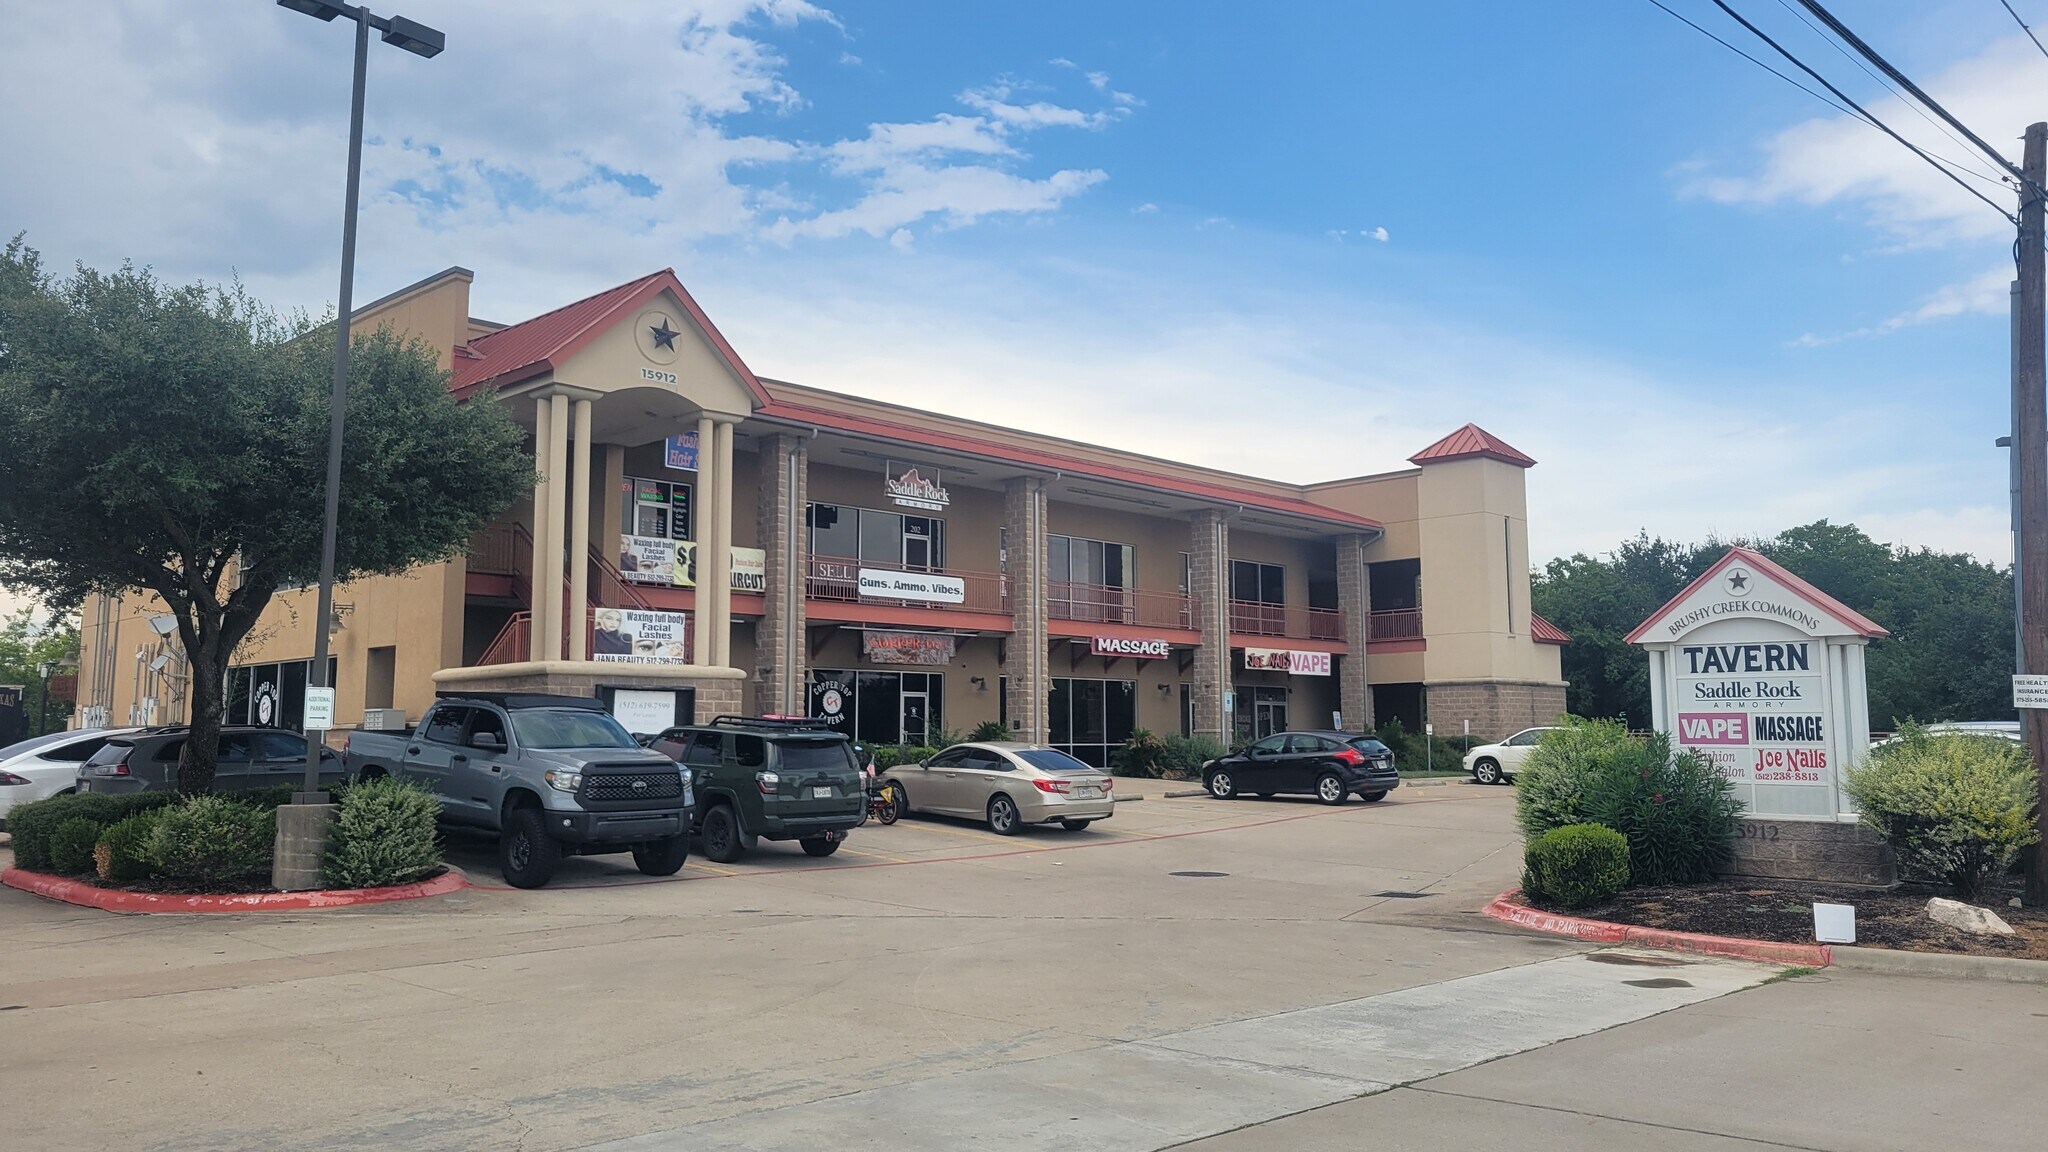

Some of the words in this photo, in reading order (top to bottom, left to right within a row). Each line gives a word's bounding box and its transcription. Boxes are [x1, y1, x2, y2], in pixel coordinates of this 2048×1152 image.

[641, 368, 677, 384] 15912
[669, 449, 693, 468] Hair
[640, 491, 664, 501] WAXING
[888, 479, 922, 498] Saddle
[924, 485, 950, 502] Rock
[898, 499, 940, 510] ARMORY
[910, 525, 921, 534] 202
[633, 538, 653, 549] Waxing
[660, 540, 675, 550] body
[644, 547, 665, 556] Facial
[641, 553, 666, 561] Lashes
[819, 563, 852, 579] SELL
[859, 576, 891, 589] Guns.
[893, 580, 929, 593] Ammo.
[931, 583, 964, 596] Vibes.
[626, 611, 653, 623] Waxing
[654, 613, 667, 622] full
[667, 613, 685, 626] body
[1668, 605, 1712, 636] BRUSHY
[1712, 600, 1751, 615] CREEK
[1751, 600, 1820, 631] COMMONS
[639, 630, 673, 640] Lashes
[642, 623, 671, 632] Facial
[1097, 637, 1170, 656] MASSAGE
[595, 655, 616, 663] JANA
[1291, 653, 1329, 673] VAPE
[1683, 643, 1810, 674] TAVERN
[812, 680, 839, 695] COPPER
[840, 683, 853, 697] TOP
[1694, 681, 1752, 699] Saddle
[1755, 680, 1802, 698] Rock
[1713, 701, 1785, 709] ARMORY
[1681, 718, 1743, 740] VAPE
[1755, 715, 1824, 742] MASSAGE
[1755, 748, 1784, 772] Joe
[1786, 748, 1827, 772] Nails
